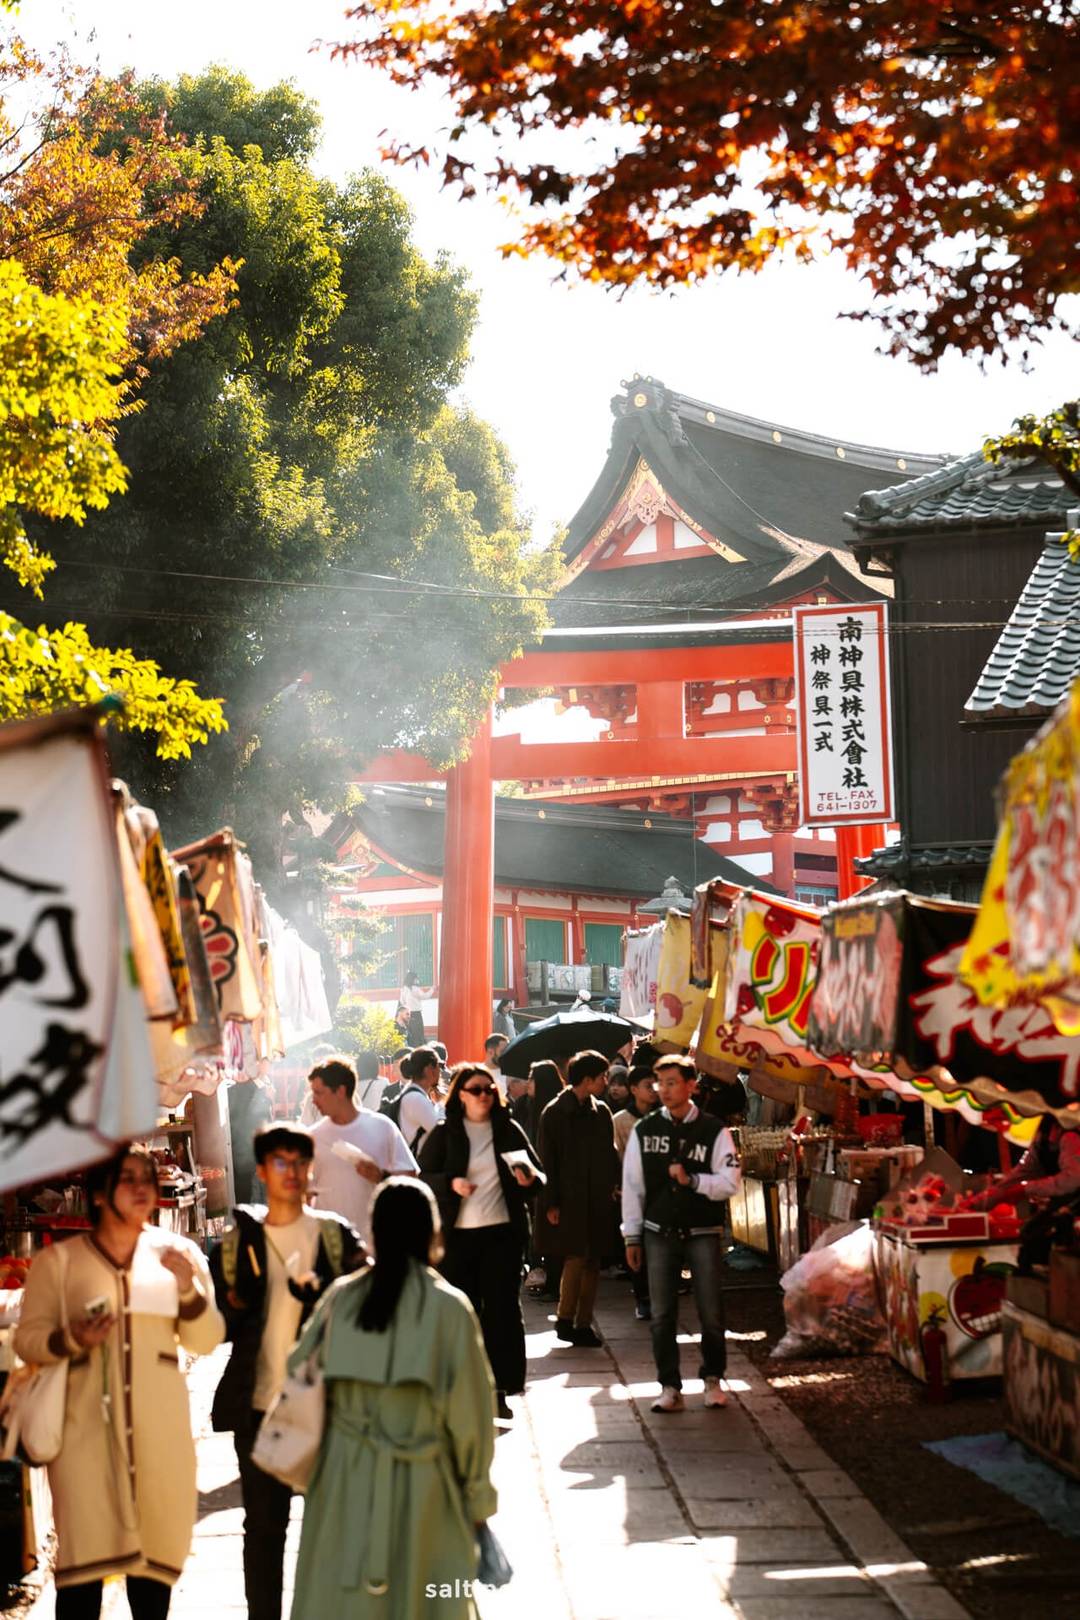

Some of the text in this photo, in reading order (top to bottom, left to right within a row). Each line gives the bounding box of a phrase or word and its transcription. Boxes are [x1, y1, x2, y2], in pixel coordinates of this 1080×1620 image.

[810, 644, 834, 752] 神祭具一式
[817, 799, 877, 812] 641-1307
